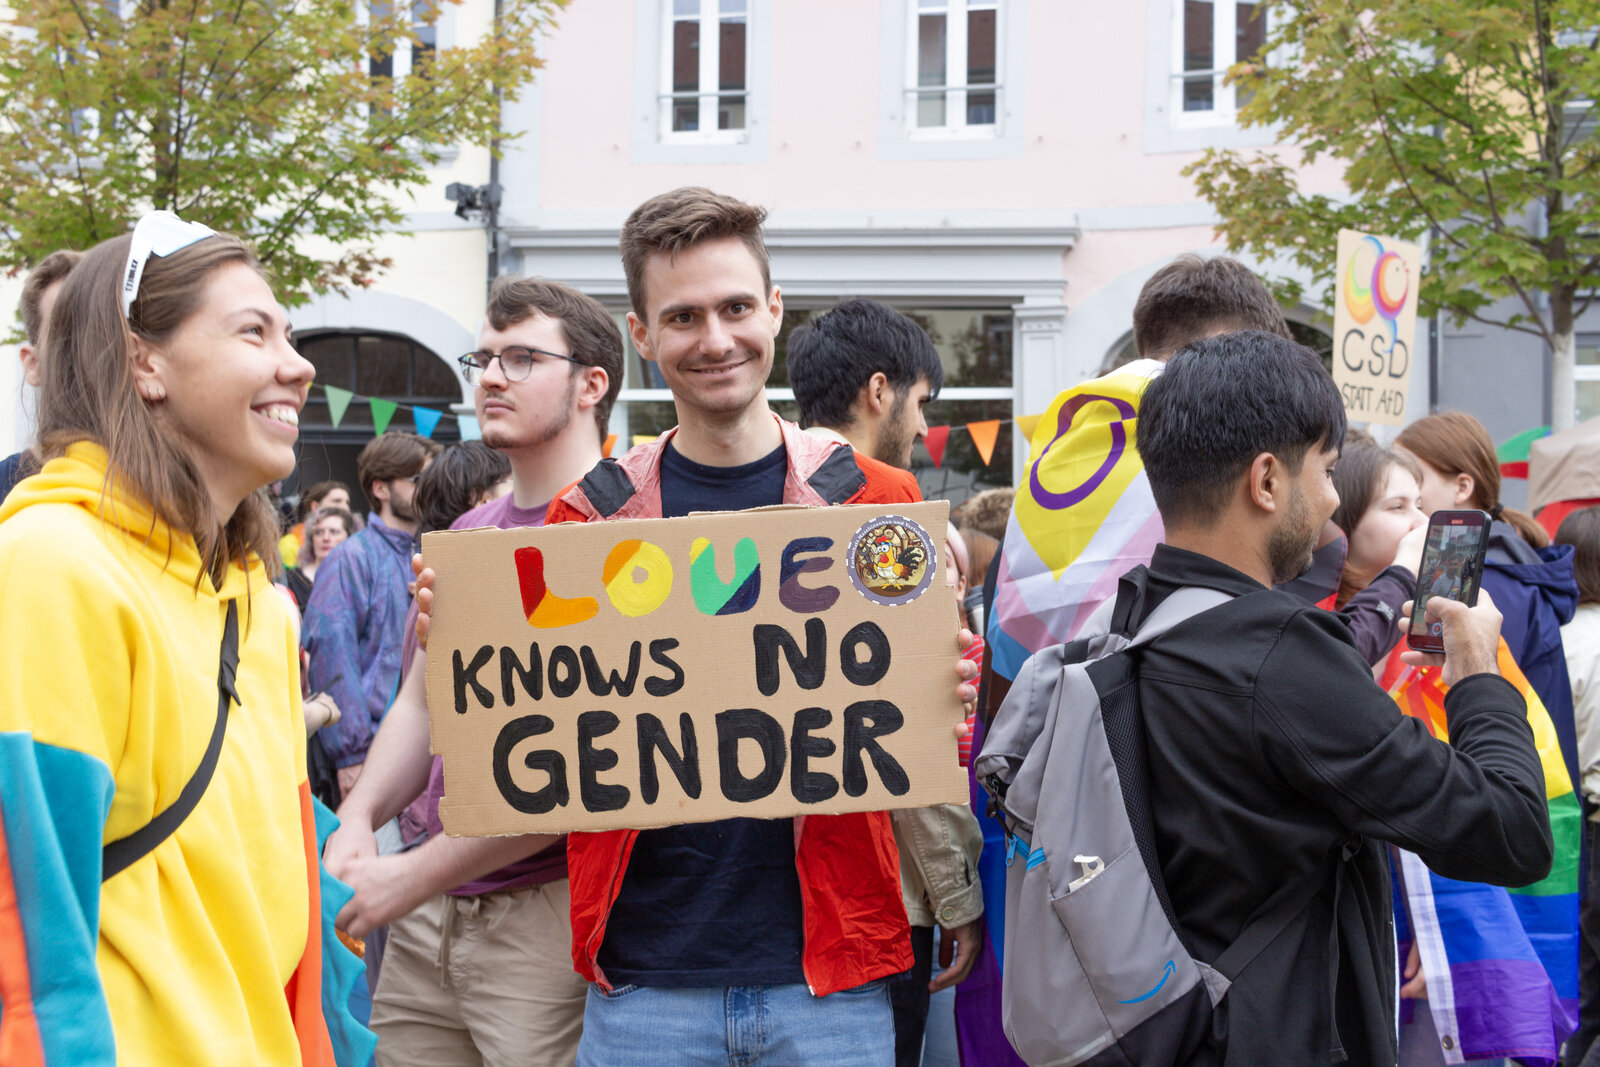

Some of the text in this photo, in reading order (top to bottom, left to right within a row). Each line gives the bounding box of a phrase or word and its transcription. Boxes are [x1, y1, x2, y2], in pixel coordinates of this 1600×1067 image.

[1342, 328, 1408, 379] CSD
[1342, 382, 1404, 416] STATT AfD
[452, 617, 891, 714] KNOWS NO
[493, 700, 910, 814] GENDER
